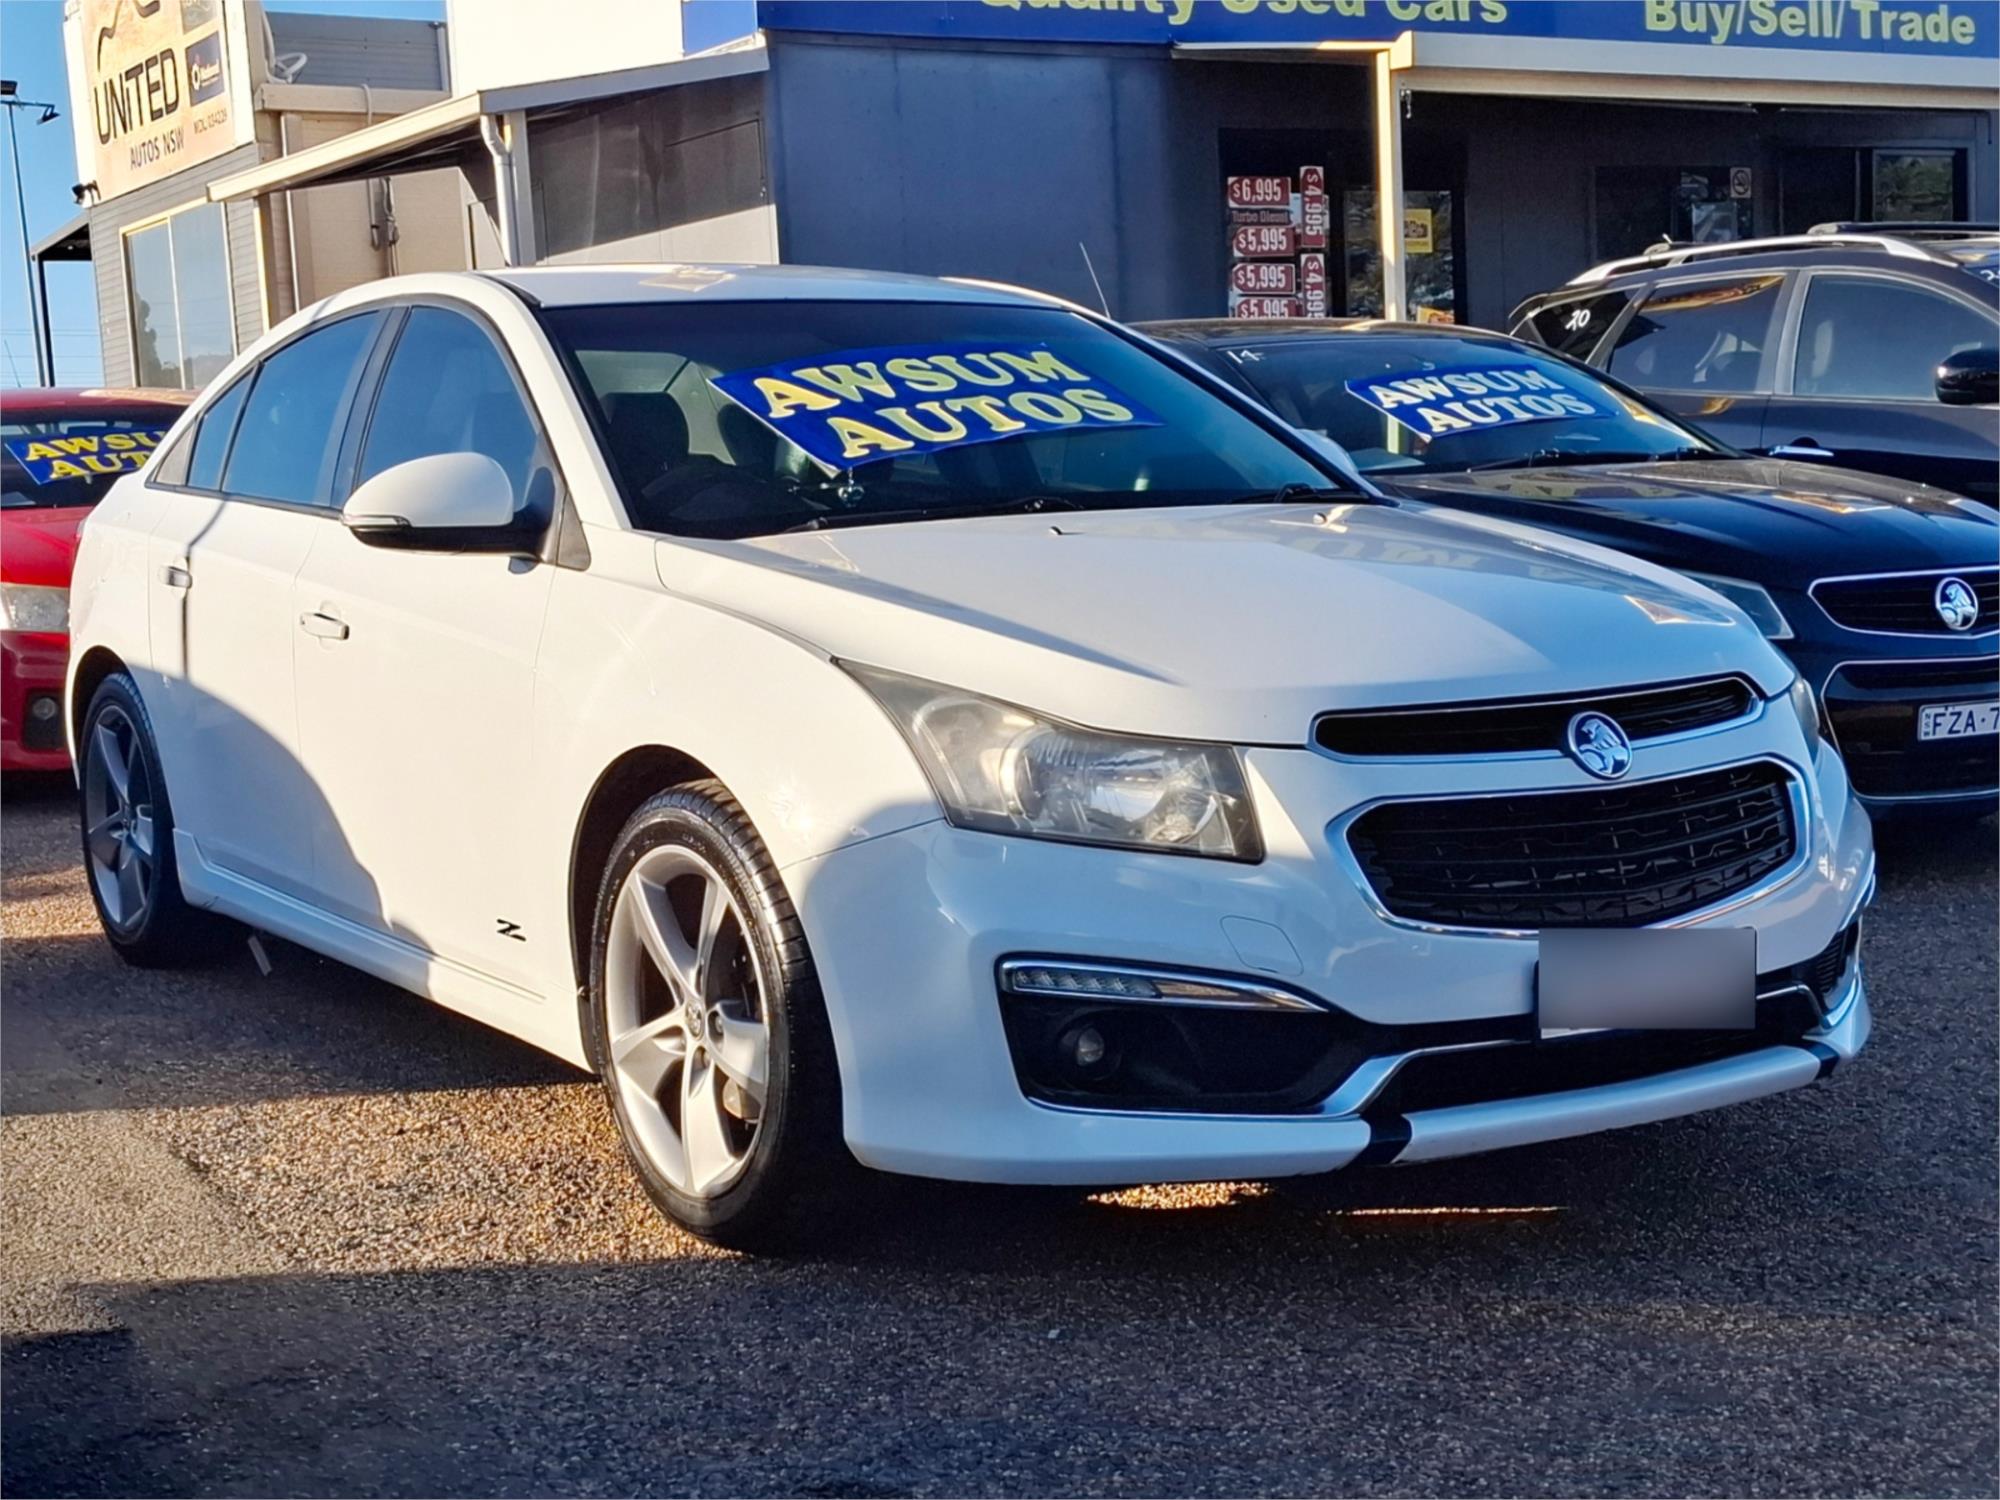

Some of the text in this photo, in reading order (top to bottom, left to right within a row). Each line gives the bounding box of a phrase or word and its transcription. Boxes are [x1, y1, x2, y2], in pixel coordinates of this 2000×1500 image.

[94, 48, 179, 145] UNITED
[130, 127, 185, 170] AUTOS NSW
[1233, 178, 1281, 202] $6,995
[1304, 174, 1323, 235] $4,995
[1238, 228, 1287, 252] $5,995
[1237, 266, 1286, 289] $5,995
[753, 350, 1091, 419] AWSUM
[1368, 369, 1565, 409] AWSUM
[825, 388, 1134, 458] AUTOS
[1417, 391, 1596, 433] AUTOS
